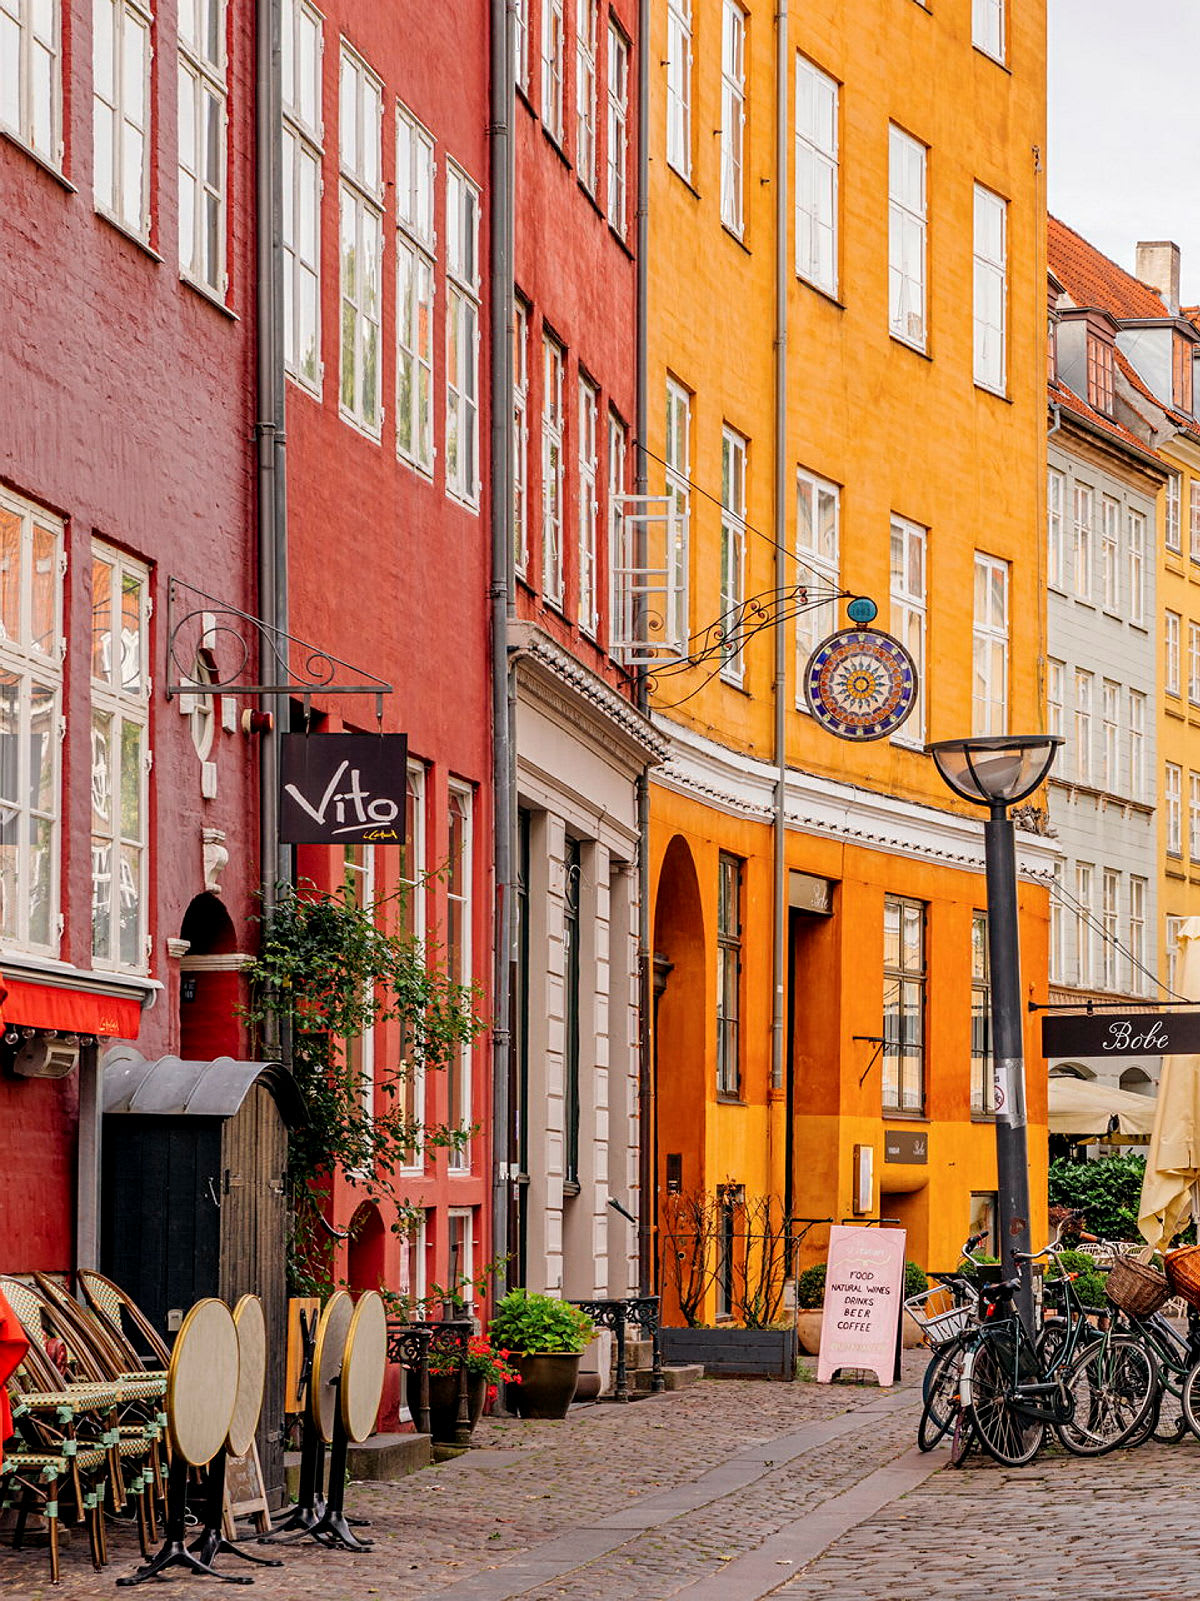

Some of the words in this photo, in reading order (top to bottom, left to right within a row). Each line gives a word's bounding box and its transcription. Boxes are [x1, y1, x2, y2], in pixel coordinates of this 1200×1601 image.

[285, 760, 398, 825] Vito
[1102, 1020, 1169, 1050] Bobe
[849, 1271, 874, 1280] FOOD
[831, 1284, 862, 1293] NATURAL
[866, 1286, 891, 1295] WINES
[844, 1296, 874, 1306] DRINKS
[844, 1308, 871, 1318] BEER
[837, 1321, 871, 1332] COFFEE
